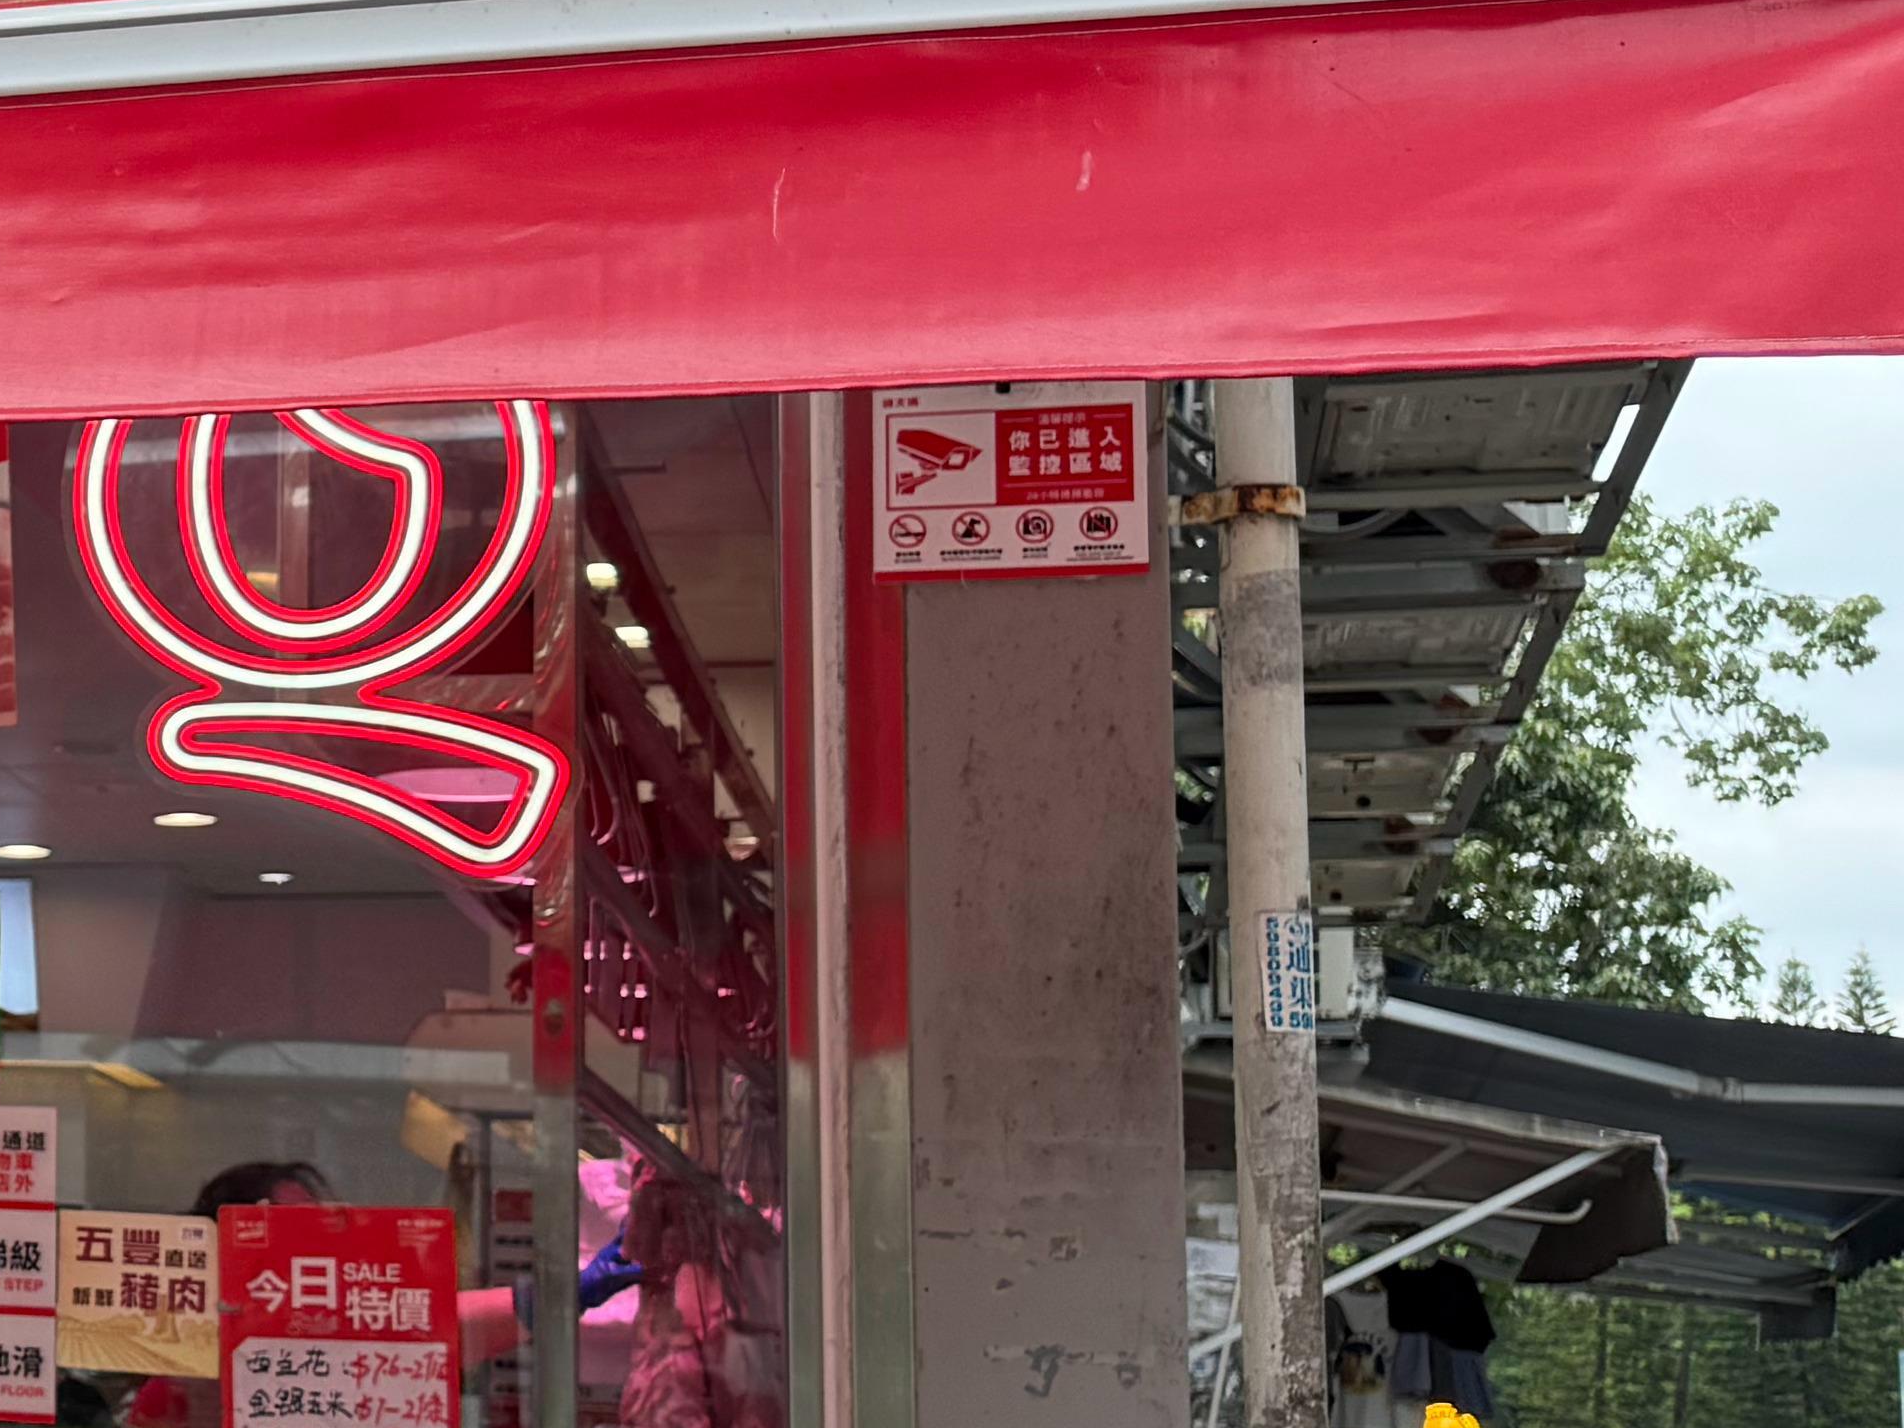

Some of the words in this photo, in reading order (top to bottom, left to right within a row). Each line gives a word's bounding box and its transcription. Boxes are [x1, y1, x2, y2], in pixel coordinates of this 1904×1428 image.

[342, 1261, 402, 1284] SALE
[4, 1276, 43, 1293] STEP
[0, 1383, 45, 1398] FLOOR
